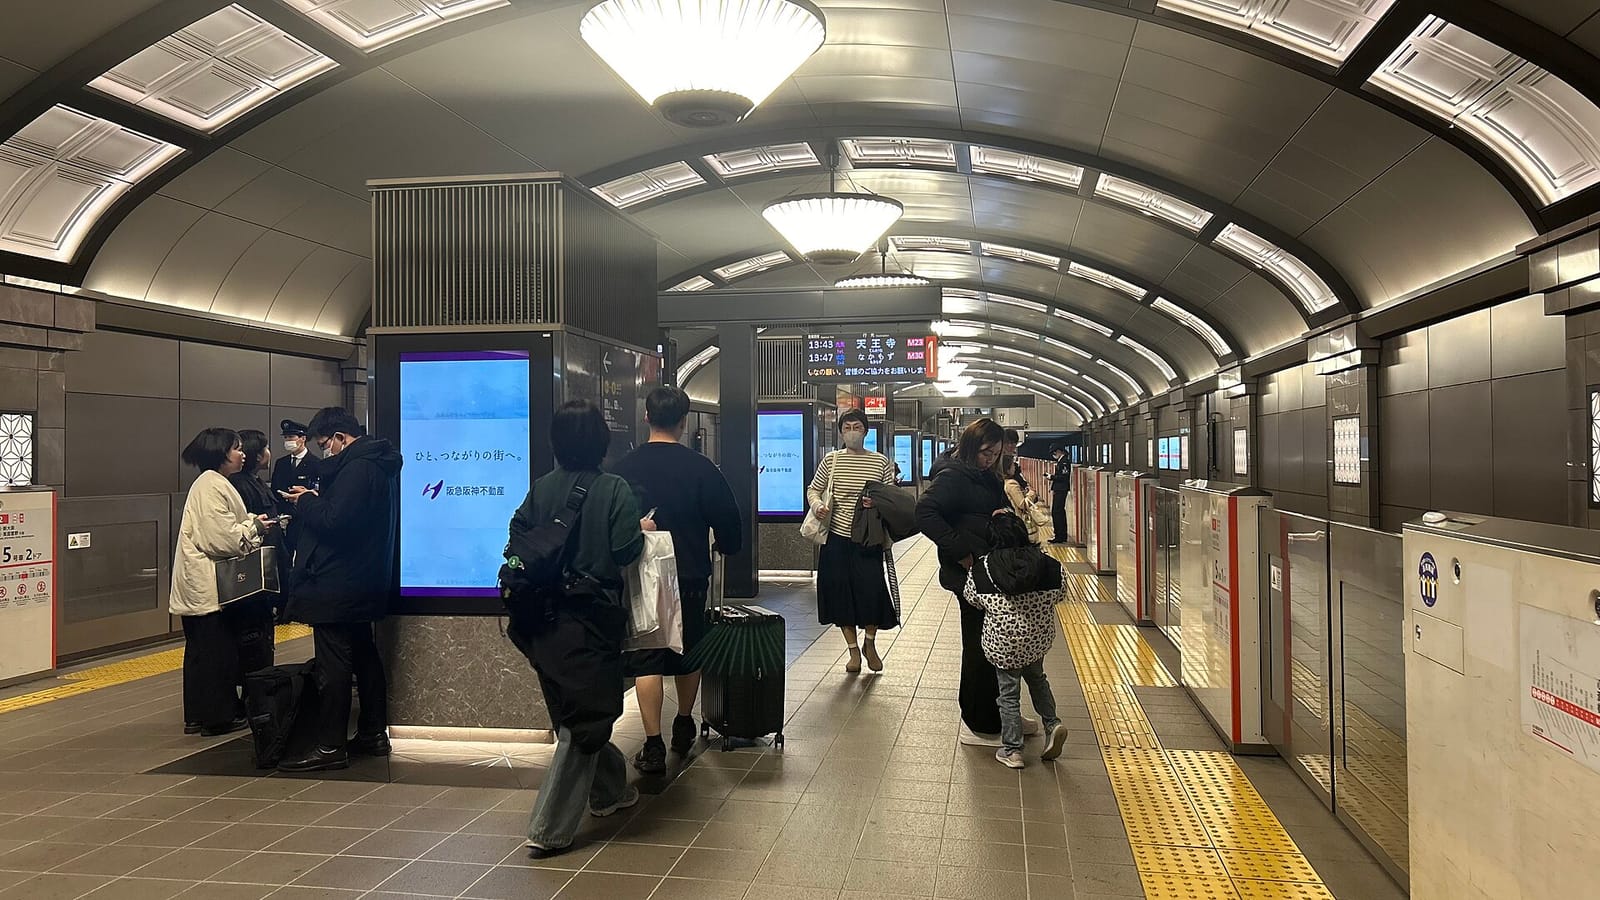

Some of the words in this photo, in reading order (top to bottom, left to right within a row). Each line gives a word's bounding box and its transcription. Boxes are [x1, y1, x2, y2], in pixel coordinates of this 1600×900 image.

[808, 340, 834, 349] 13:43
[856, 337, 896, 349] 天王寺
[907, 339, 924, 347] M23
[808, 353, 834, 362] 13:47
[857, 352, 895, 361] なかもず
[907, 352, 924, 360] M30
[415, 450, 522, 461] ひと、つながりの街へ。
[446, 486, 504, 496] 阪急阪神不動産
